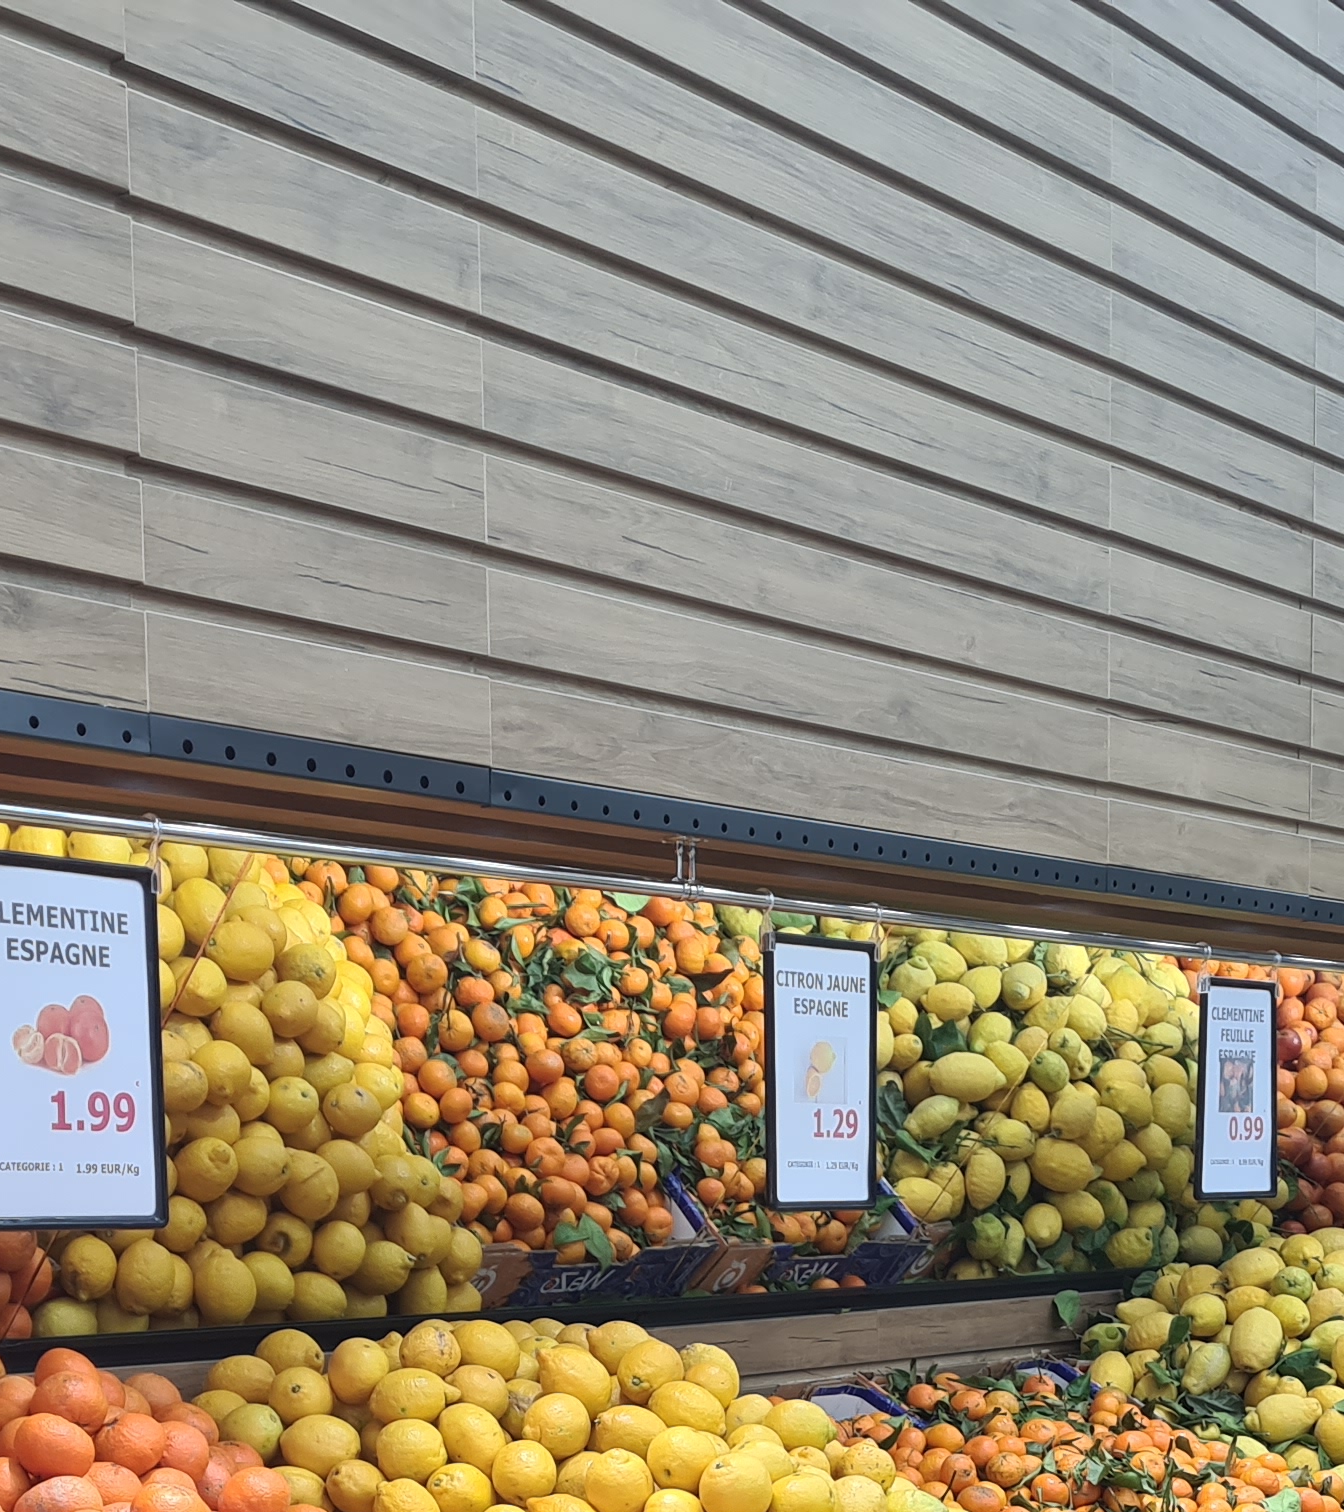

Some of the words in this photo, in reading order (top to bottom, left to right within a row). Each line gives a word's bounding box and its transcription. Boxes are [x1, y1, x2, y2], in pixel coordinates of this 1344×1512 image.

[6, 937, 111, 968] ESPAGNE
[776, 969, 824, 991] CITRON
[827, 974, 866, 994] JAUNE
[793, 997, 849, 1018] ESPAGNE
[1211, 1006, 1265, 1023] CLEMENTINE
[1220, 1028, 1254, 1043] FEUILLE
[50, 1090, 136, 1132] 1.99
[812, 1108, 858, 1139] 1.29
[1228, 1116, 1264, 1141] 0.99
[0, 1161, 51, 1172] CATEGORIE
[76, 1163, 98, 1174] 1.99
[101, 1163, 140, 1176] EUR/Kg
